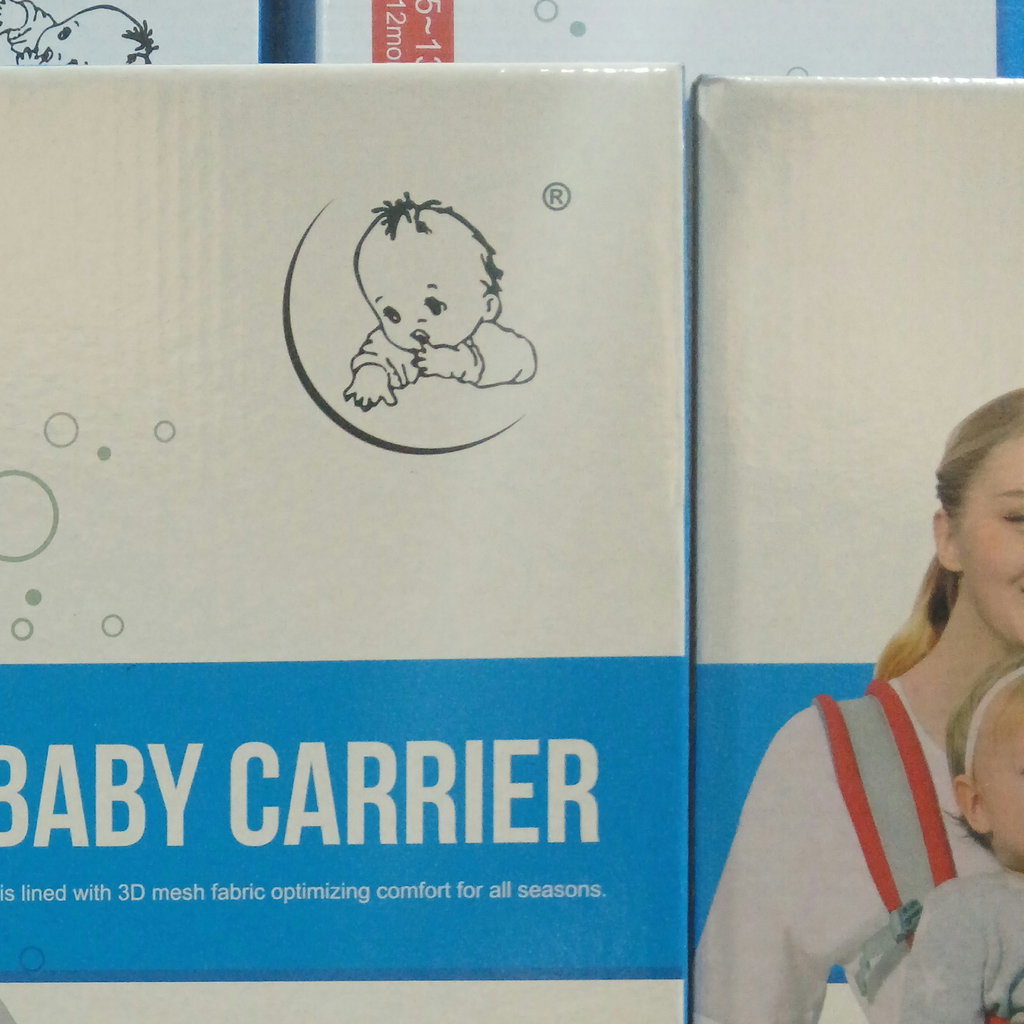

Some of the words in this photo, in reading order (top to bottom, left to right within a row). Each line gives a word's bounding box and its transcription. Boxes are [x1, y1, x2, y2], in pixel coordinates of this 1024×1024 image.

[229, 738, 601, 848] CARRIER
[0, 884, 15, 902] is
[21, 884, 67, 902] lined
[73, 884, 111, 901] with
[118, 883, 145, 901] 3D
[152, 883, 205, 901] mesh
[210, 882, 266, 901] fabric
[270, 881, 371, 904] optimizing
[376, 881, 452, 900] comfort
[456, 880, 484, 899] for
[489, 880, 513, 899] all
[517, 882, 607, 899] seasons.
